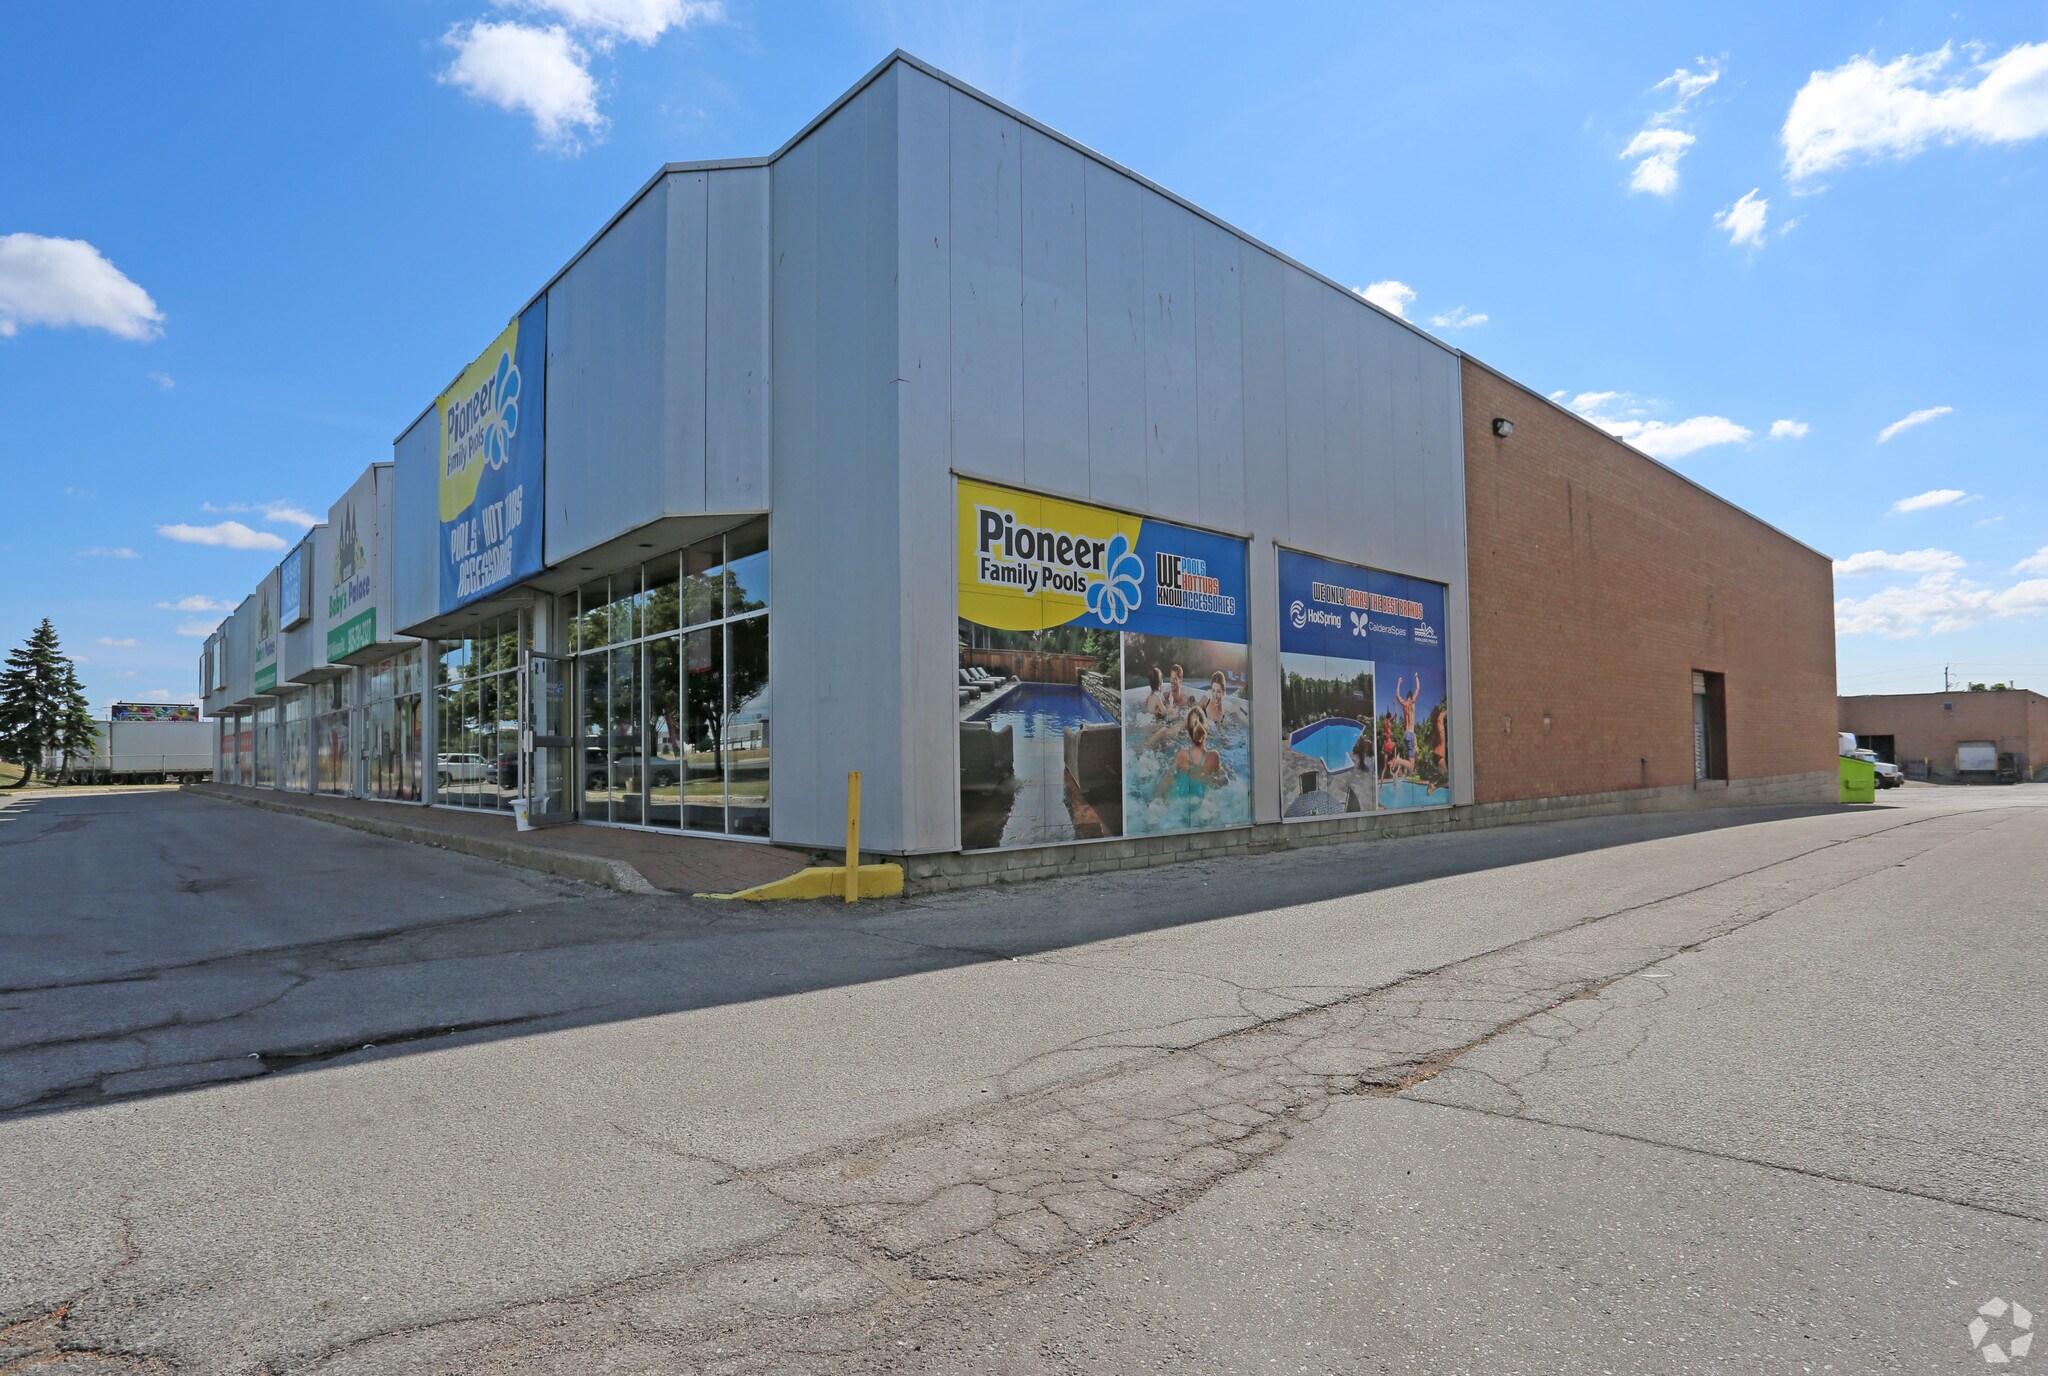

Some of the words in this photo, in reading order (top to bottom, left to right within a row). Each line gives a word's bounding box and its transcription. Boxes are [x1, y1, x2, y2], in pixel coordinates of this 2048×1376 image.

[447, 374, 496, 450] Pioneer
[447, 443, 467, 476] Family
[469, 425, 484, 459] Pools
[482, 501, 504, 546] HOT
[980, 508, 1105, 570] Pioneer
[981, 557, 1038, 593] Family
[1042, 566, 1087, 593] Pools
[1157, 553, 1181, 589] WE
[1182, 558, 1206, 577] POOLS
[329, 588, 347, 619] Baby's
[348, 575, 370, 606] Palace
[1157, 586, 1182, 607] KNOW
[1183, 591, 1236, 614] ACCESSORIES
[1313, 582, 1325, 601] WE
[1326, 584, 1345, 605] ONLY
[1346, 588, 1369, 609] CARRY
[1369, 592, 1382, 612] THE
[1382, 595, 1398, 615] BEST
[1399, 599, 1423, 620] BRANDS
